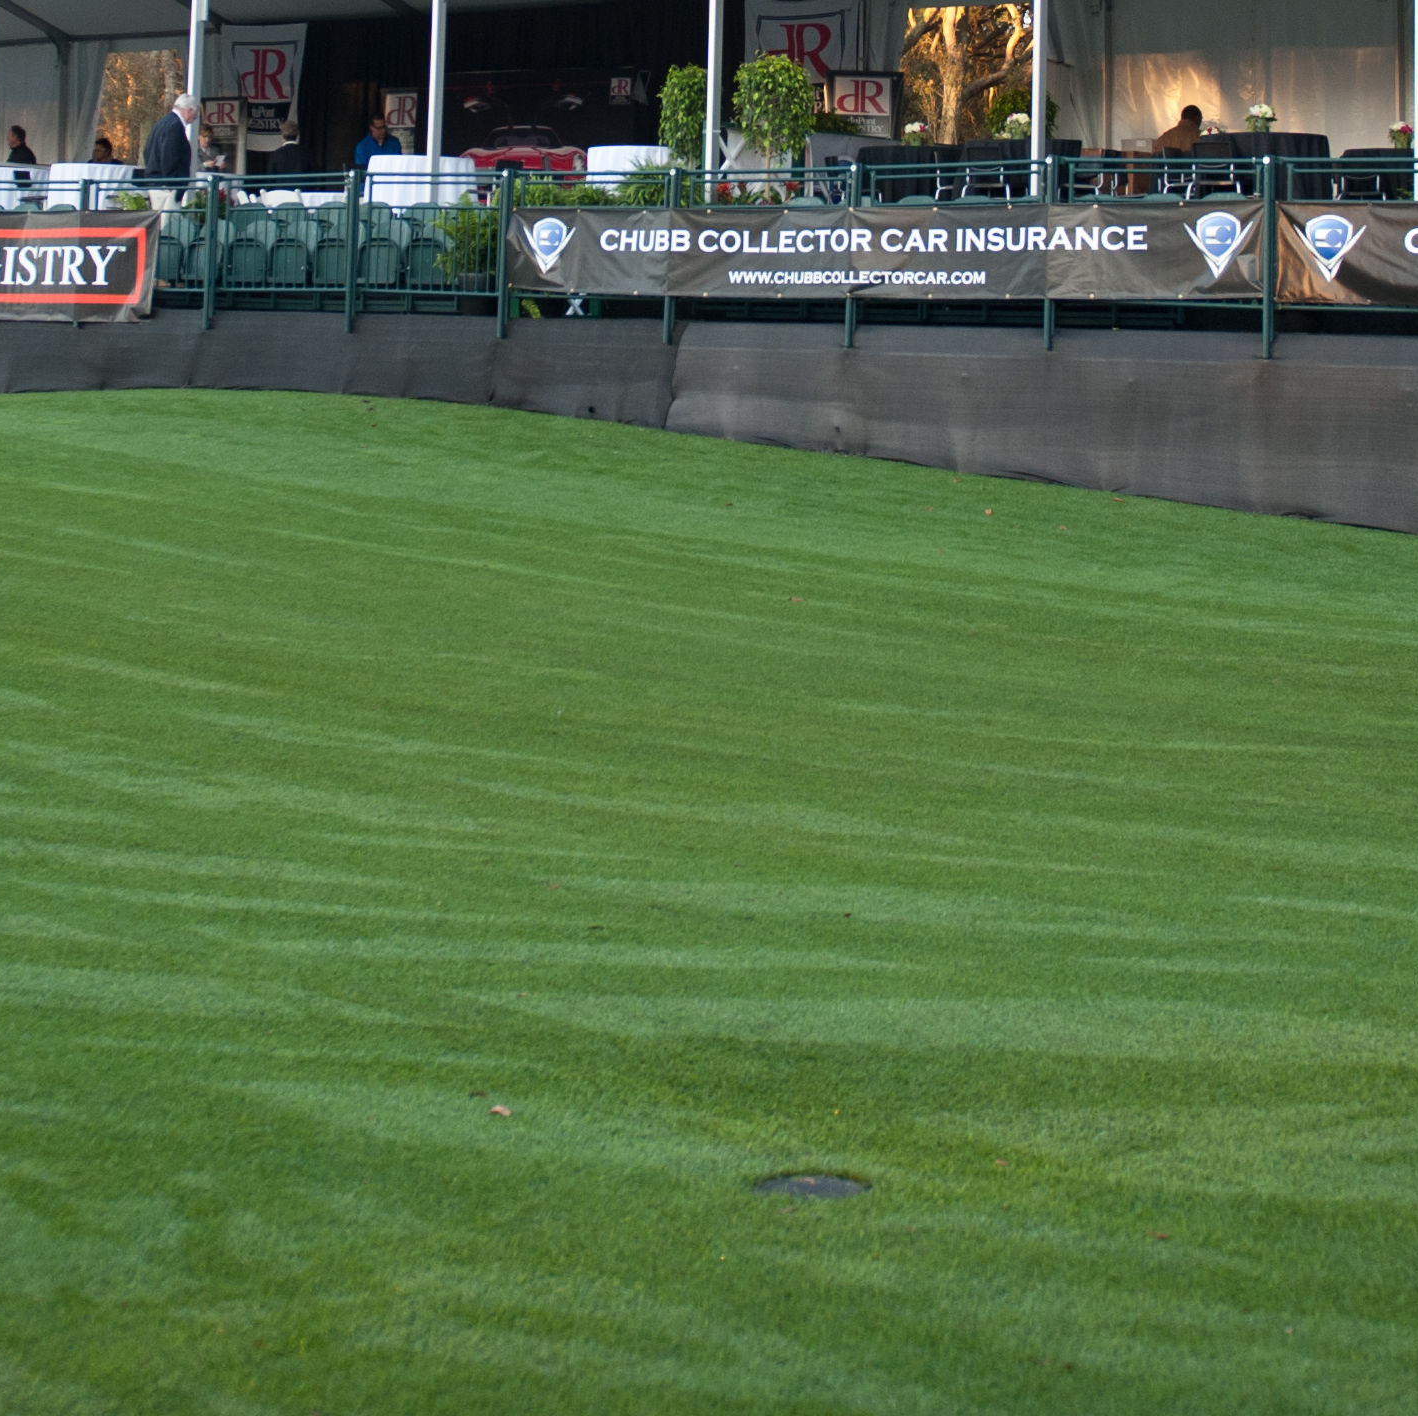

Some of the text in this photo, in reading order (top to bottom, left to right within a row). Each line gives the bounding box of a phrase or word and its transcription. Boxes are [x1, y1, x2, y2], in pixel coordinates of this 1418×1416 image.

[599, 225, 1149, 253] CHUBB COLLECTOR CAR INSURANCE
[728, 270, 986, 285] WWW.CHUBBCOLLECTORCAR.COM
